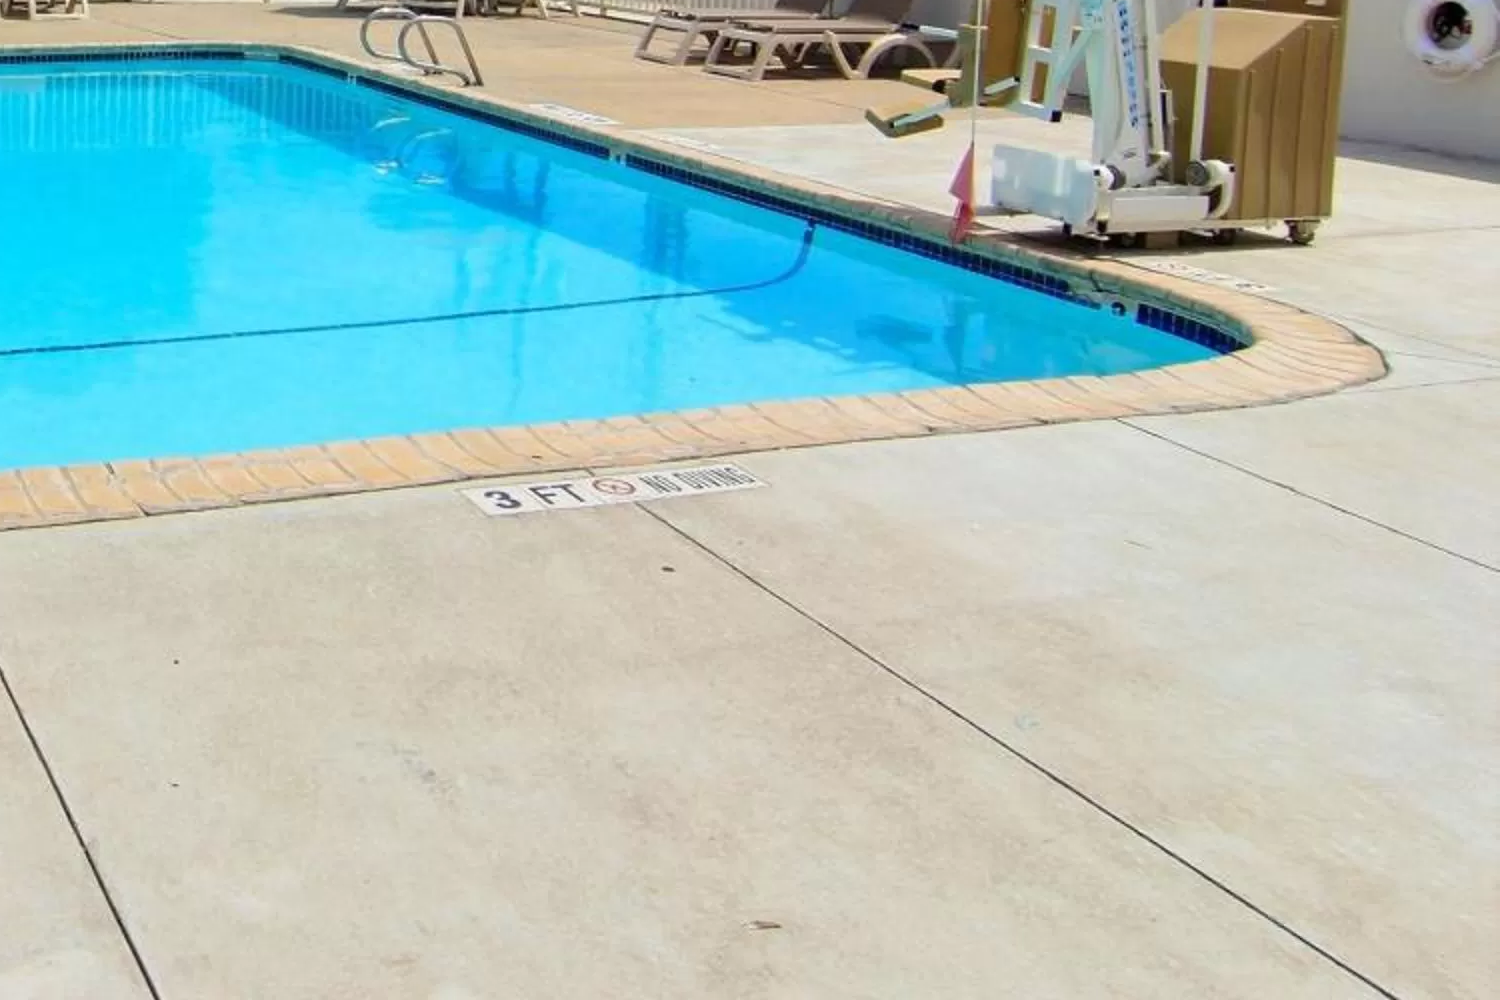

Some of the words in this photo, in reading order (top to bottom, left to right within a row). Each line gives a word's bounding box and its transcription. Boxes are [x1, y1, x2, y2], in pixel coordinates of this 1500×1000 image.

[484, 490, 522, 509] 3
[528, 483, 586, 505] FT
[638, 475, 682, 493] NO
[671, 466, 756, 489] DIVING
